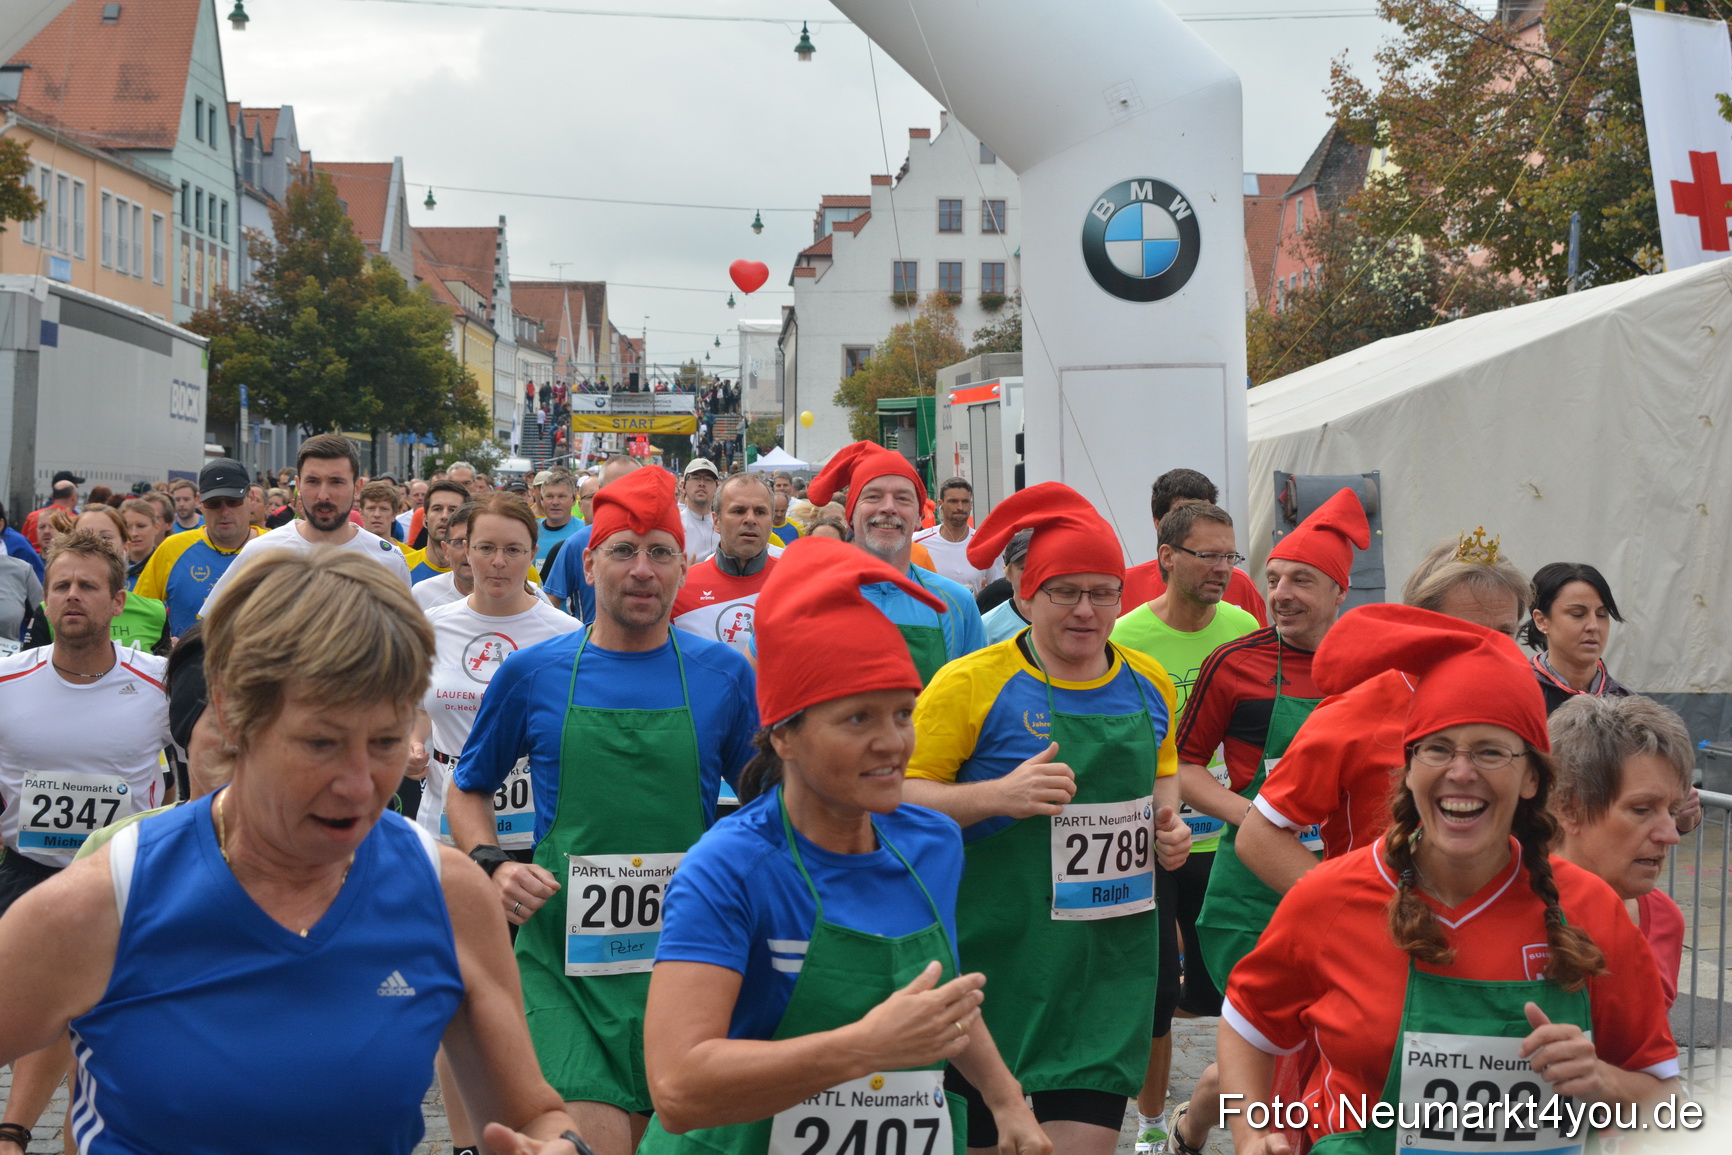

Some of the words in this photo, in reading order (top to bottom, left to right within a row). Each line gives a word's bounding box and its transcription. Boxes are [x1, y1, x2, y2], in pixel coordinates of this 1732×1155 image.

[1092, 181, 1192, 222] BMW
[612, 418, 655, 429] START
[436, 688, 475, 700] LAUFEN
[25, 779, 60, 790] PARTL
[62, 781, 113, 793] Neumarkt
[30, 794, 121, 830] 2347
[1054, 816, 1096, 827] PARTL
[1099, 811, 1141, 826] Neumarkt
[1066, 826, 1149, 876] 2789
[572, 866, 615, 878] PARTL
[1092, 883, 1130, 904] Ralph
[581, 884, 669, 928] 206
[610, 939, 646, 956] Peter
[376, 986, 417, 997] adidas
[1408, 1051, 1474, 1069] PARTL
[851, 1091, 930, 1108] Neumarkt
[794, 1117, 940, 1155] 2407
